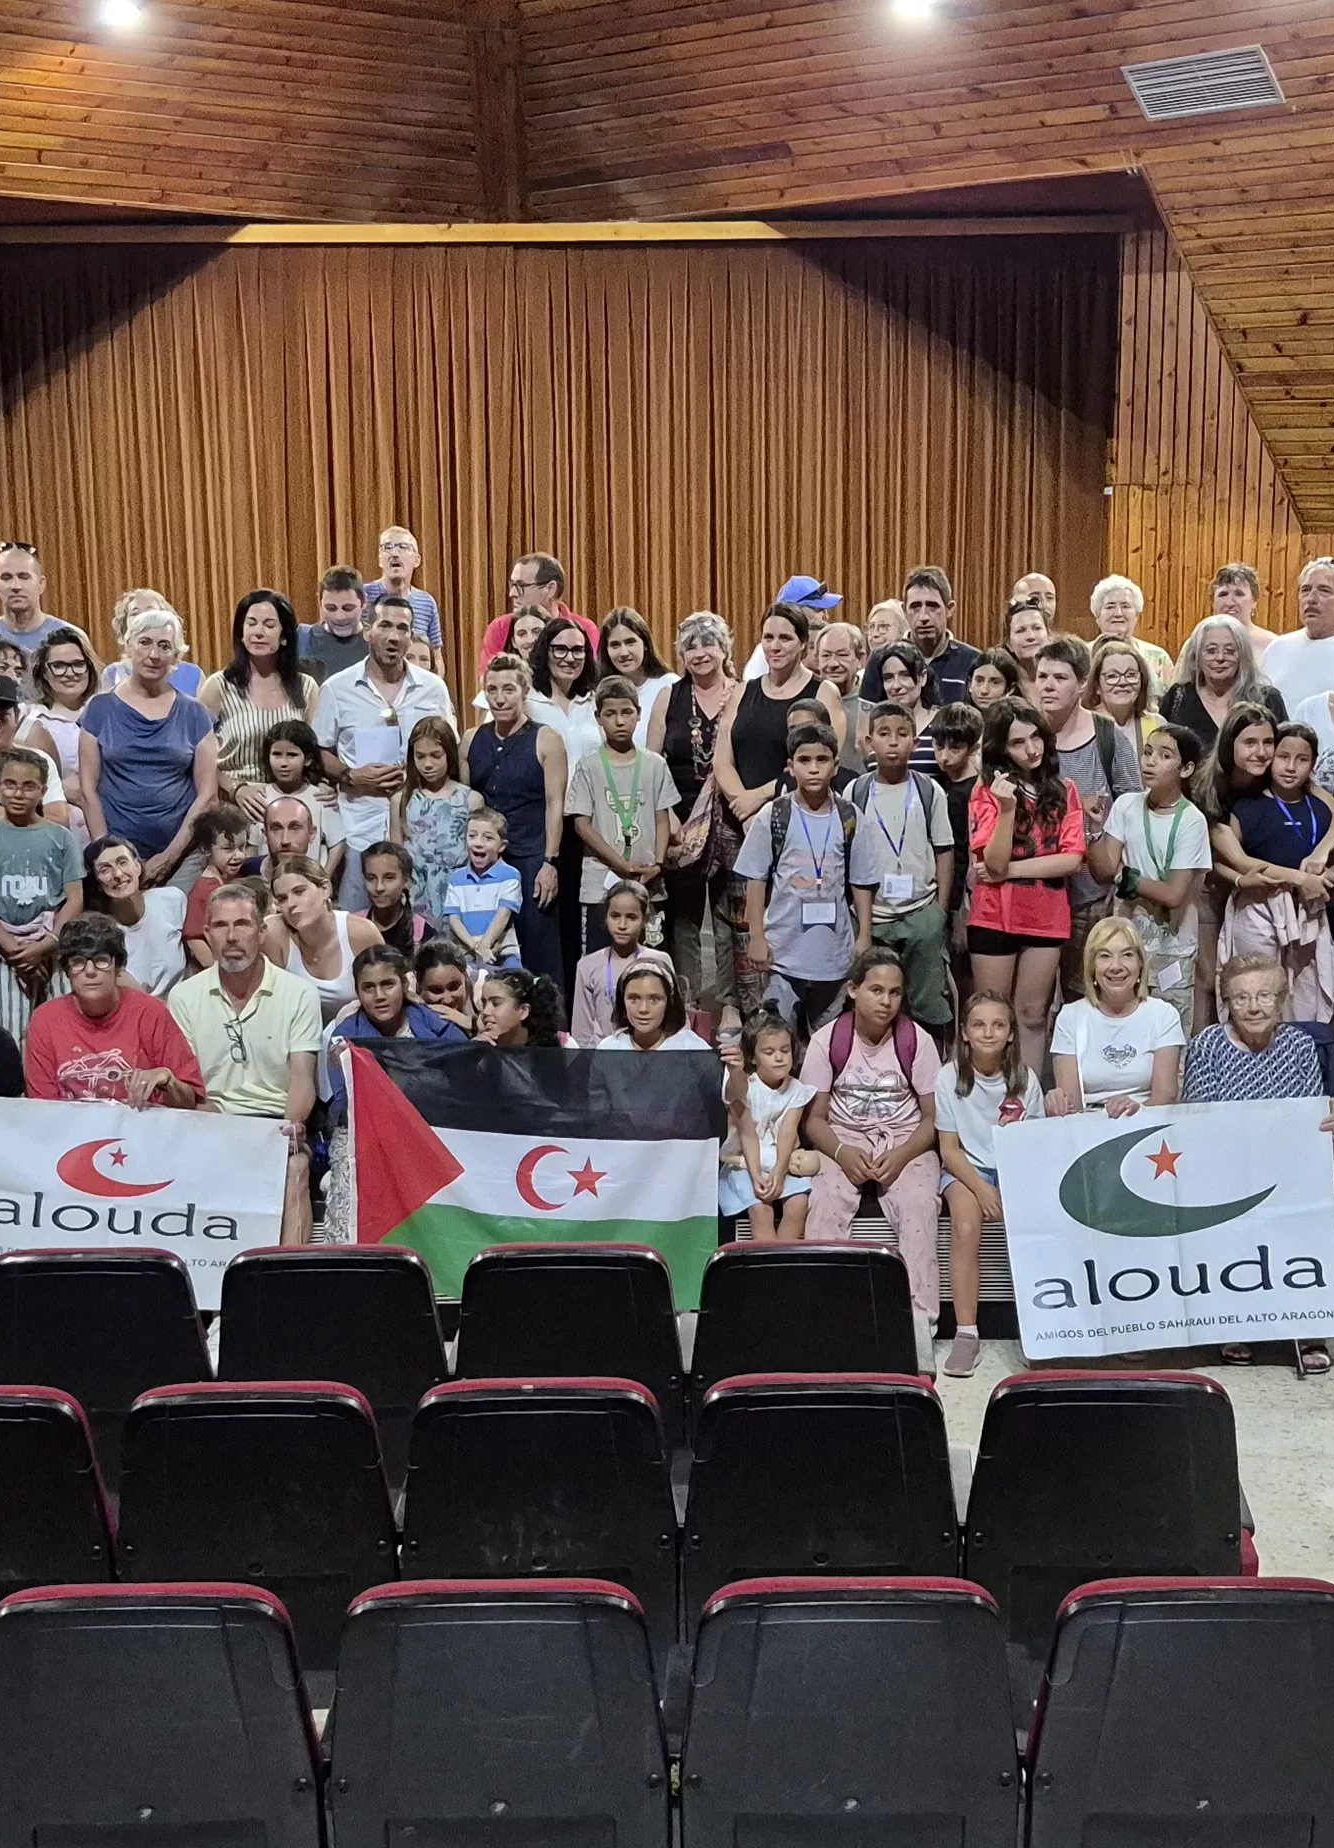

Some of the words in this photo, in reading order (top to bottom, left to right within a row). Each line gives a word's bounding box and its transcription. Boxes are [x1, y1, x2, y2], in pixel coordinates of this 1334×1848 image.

[185, 1258, 208, 1267] LTO
[1032, 1245, 1328, 1310] alouda
[1036, 1329, 1085, 1341] AMIGOS
[1088, 1327, 1109, 1338] DEL
[1111, 1321, 1156, 1335] PUEBLO
[1159, 1316, 1215, 1330] SAHARAUI
[1219, 1314, 1244, 1325] DEL
[1246, 1312, 1278, 1323] ALTO
[1281, 1309, 1334, 1321] ARAGÓN
